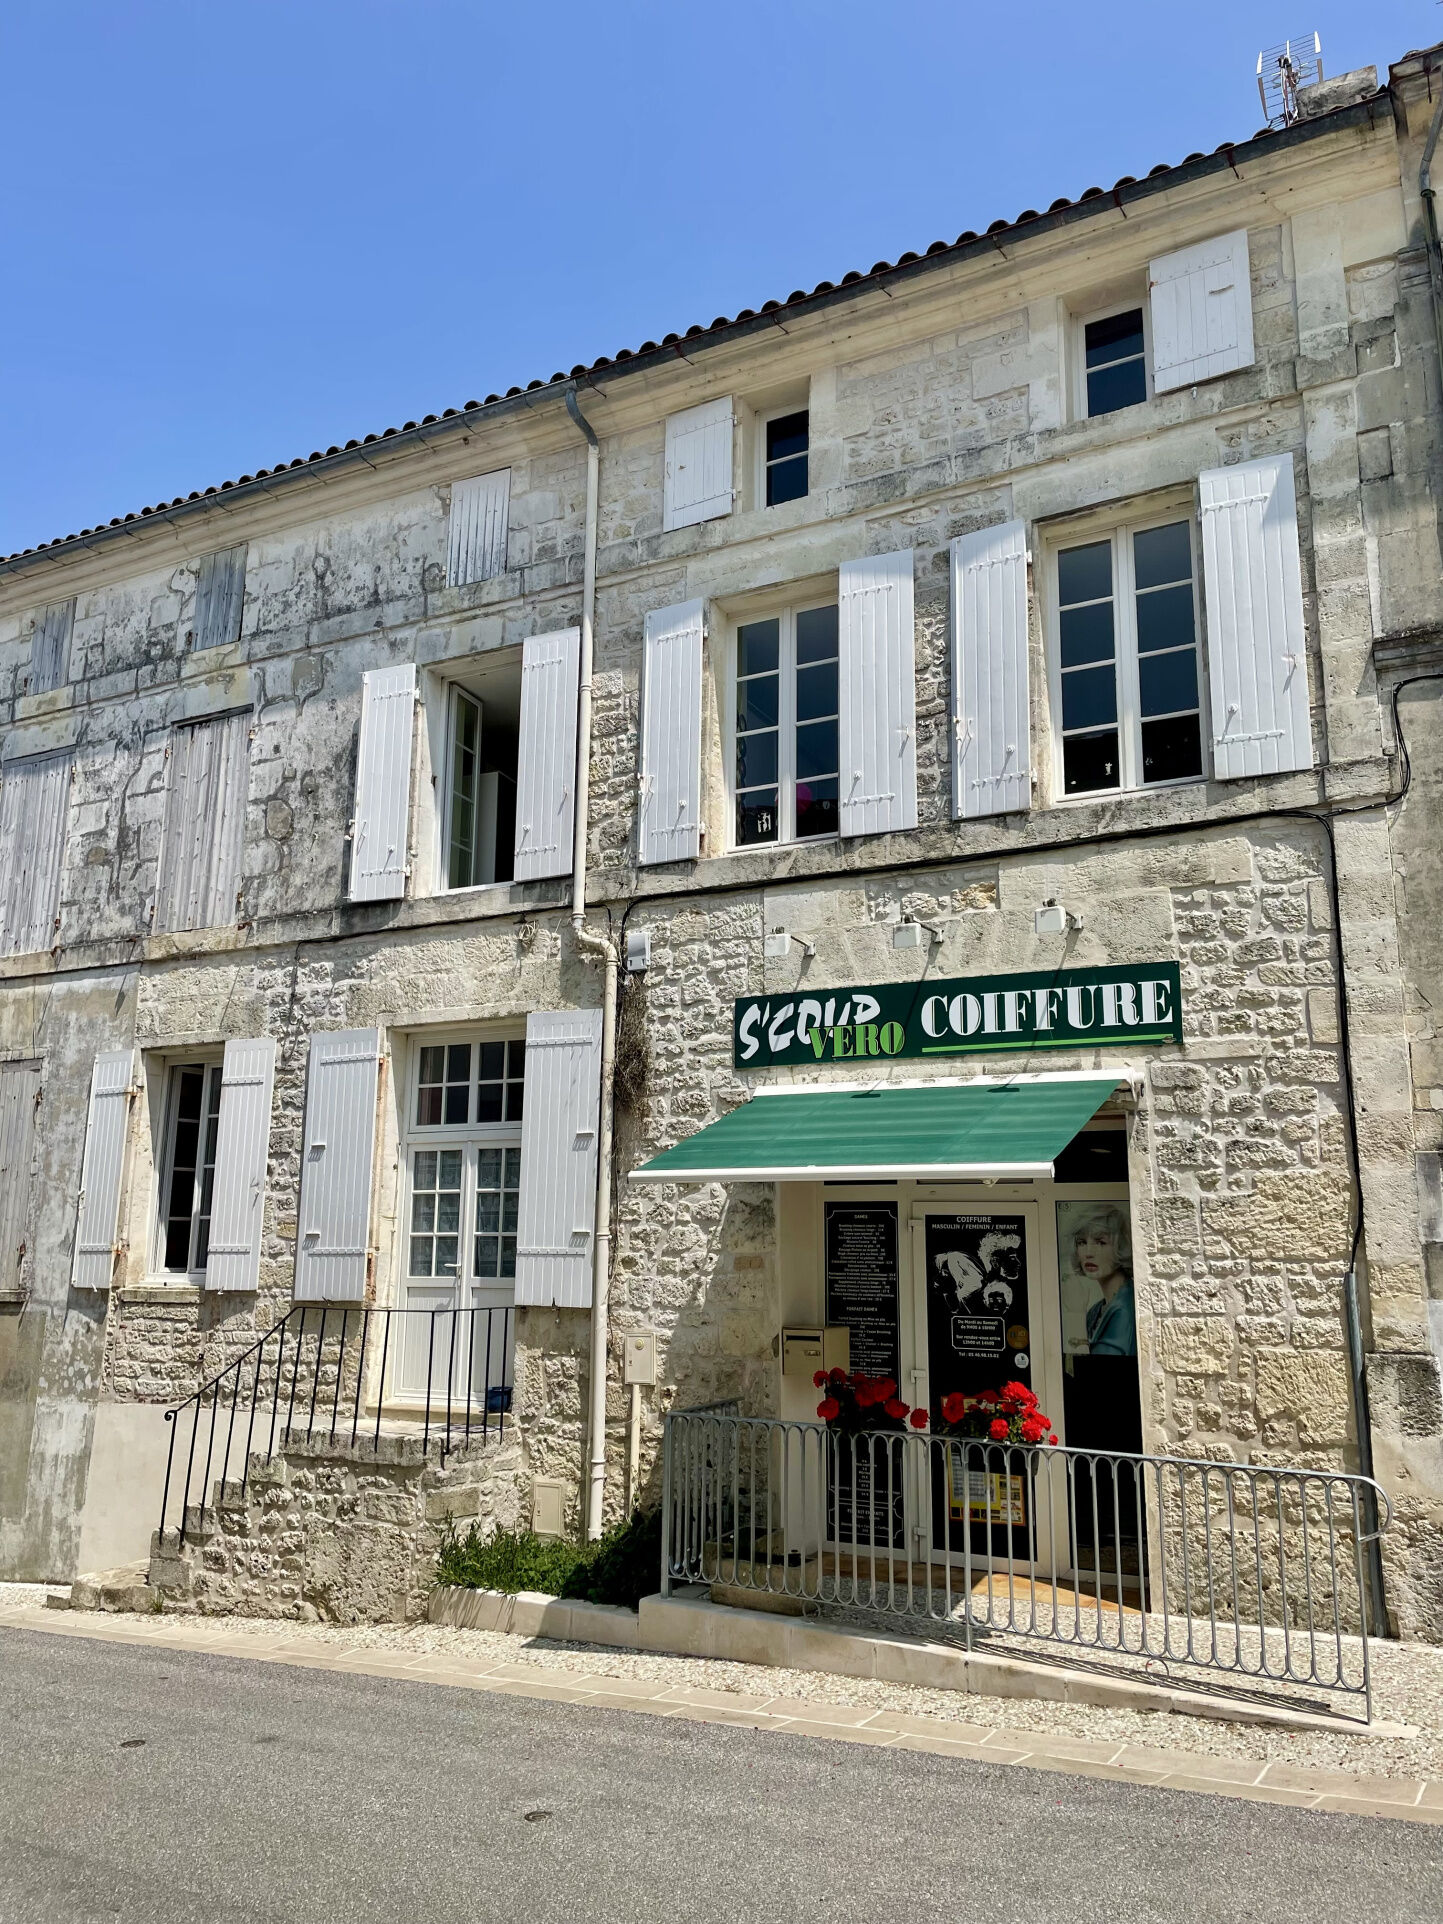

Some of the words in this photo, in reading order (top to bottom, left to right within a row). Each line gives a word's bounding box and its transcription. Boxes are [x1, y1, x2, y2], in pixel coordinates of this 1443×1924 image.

[739, 995, 881, 1060] S'COUP
[920, 980, 1173, 1038] COIFFURE
[808, 1021, 905, 1059] VERO
